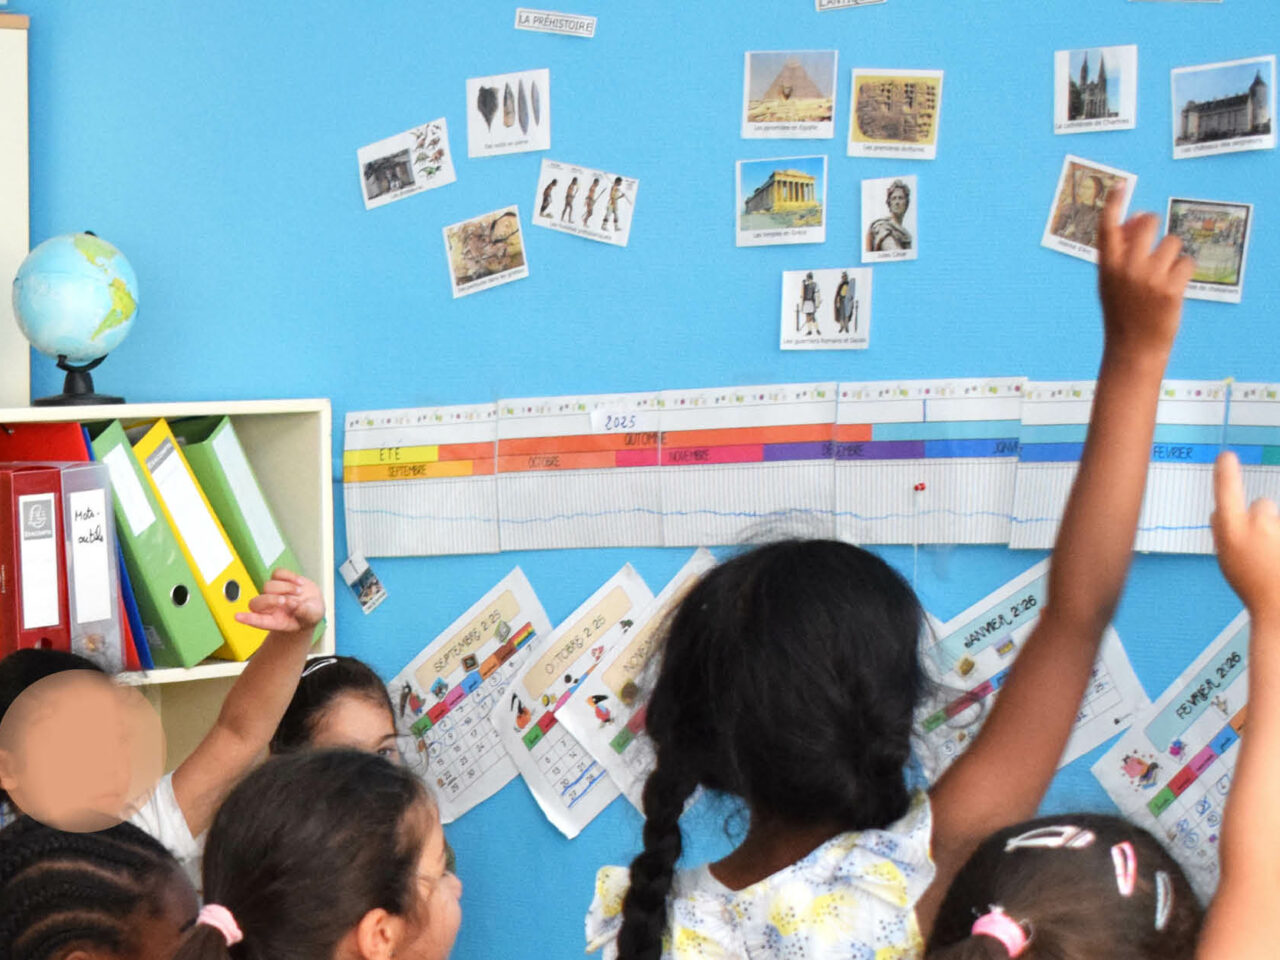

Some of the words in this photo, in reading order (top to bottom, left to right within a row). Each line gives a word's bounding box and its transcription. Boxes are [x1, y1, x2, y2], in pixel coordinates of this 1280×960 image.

[518, 14, 530, 25] LA
[532, 13, 593, 33] PRÉHISTOIRE
[604, 415, 637, 431] 2025
[480, 609, 503, 632] 225
[544, 634, 584, 675] OTOBRE
[583, 613, 606, 638] 225
